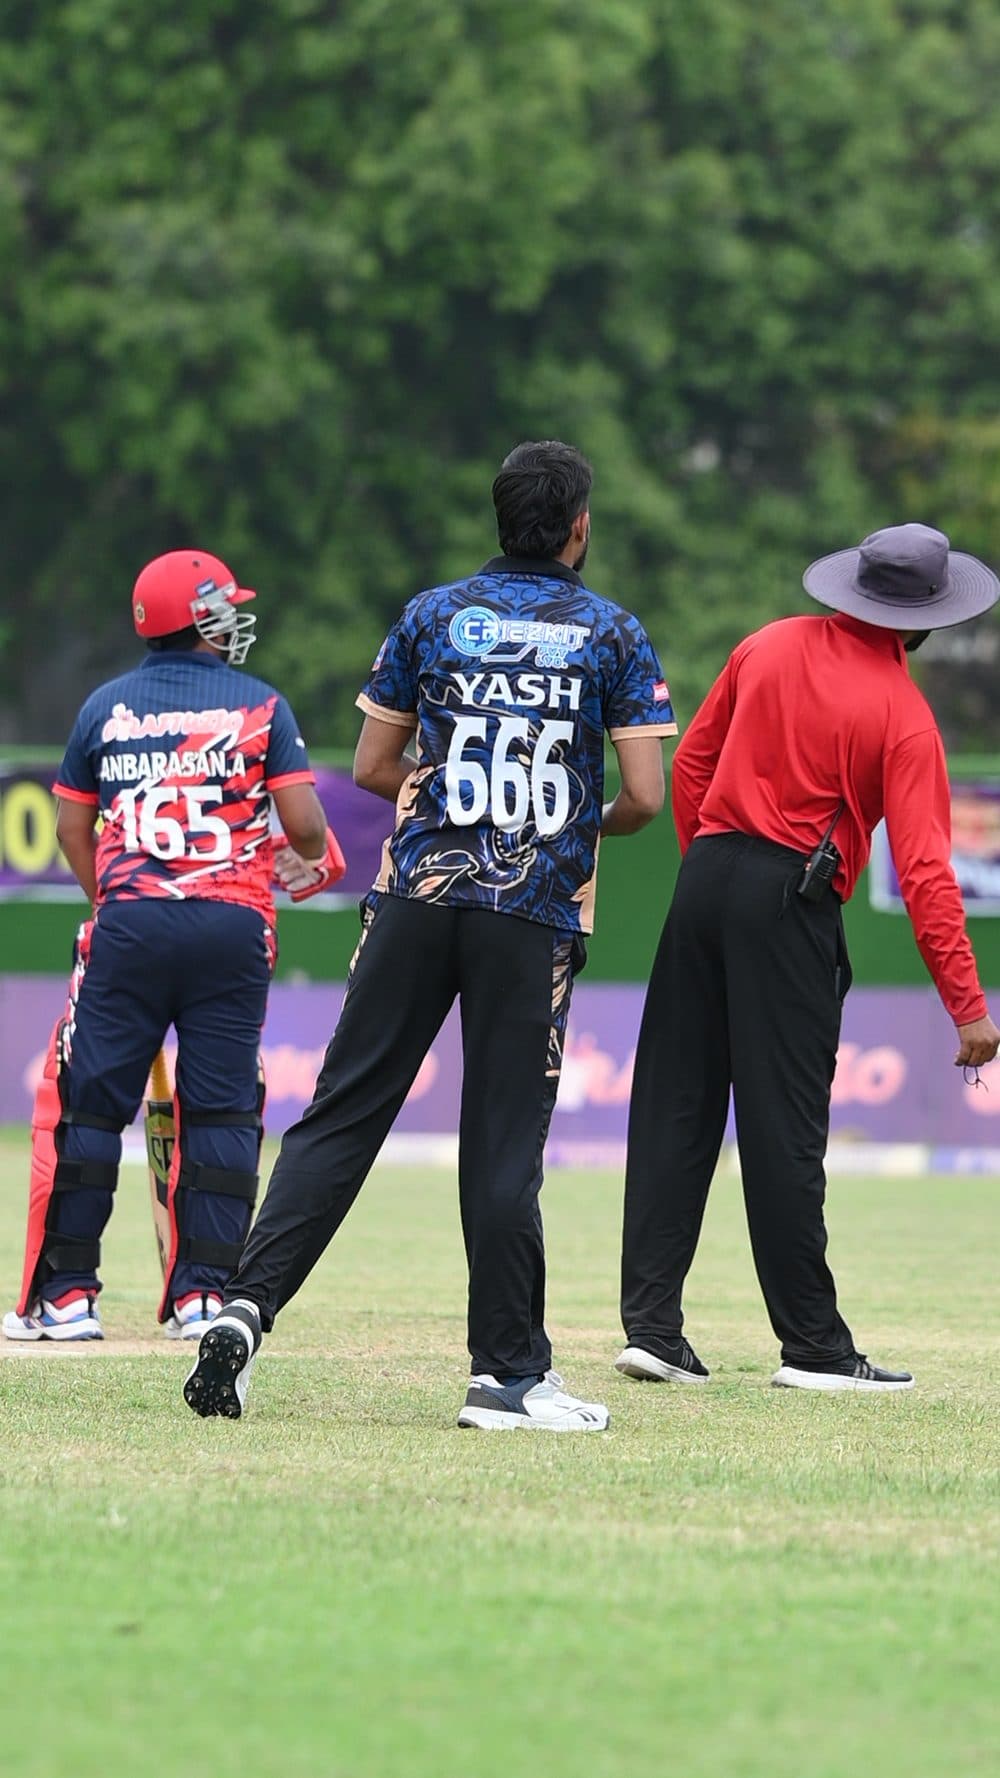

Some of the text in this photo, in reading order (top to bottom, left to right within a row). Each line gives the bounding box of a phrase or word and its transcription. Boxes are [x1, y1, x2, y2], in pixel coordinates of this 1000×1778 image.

[450, 672, 582, 710] YASH
[101, 750, 246, 782] ANBARASAN.A
[446, 716, 574, 836] 666
[118, 785, 232, 861] 165
